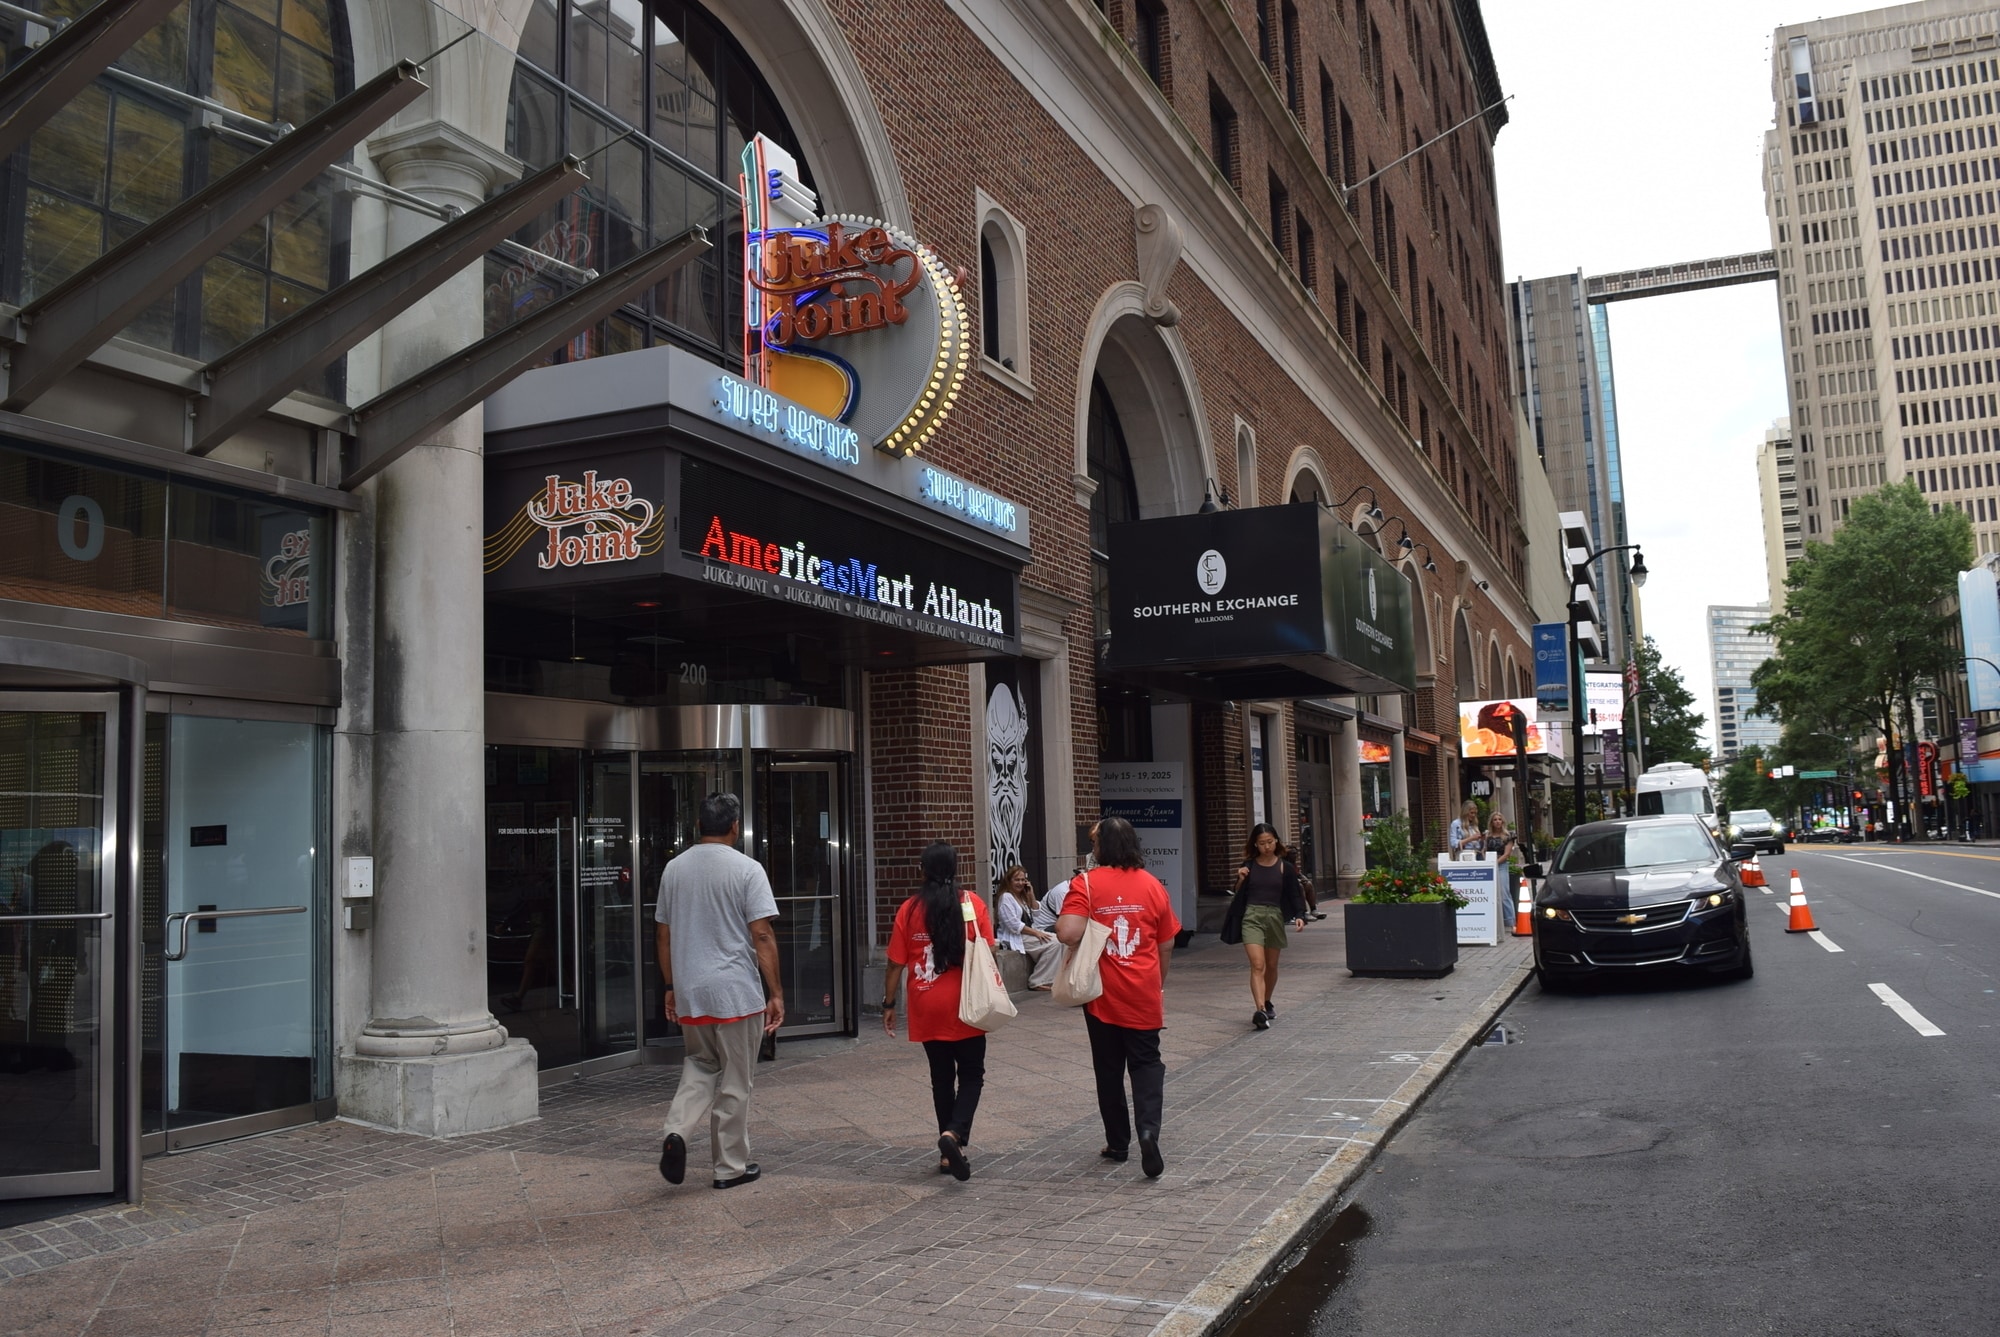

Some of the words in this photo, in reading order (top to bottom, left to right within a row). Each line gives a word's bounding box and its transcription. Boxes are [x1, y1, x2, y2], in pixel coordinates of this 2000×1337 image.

[762, 222, 893, 285] Juke
[766, 279, 909, 346] Joint
[719, 375, 779, 432] sweet
[537, 470, 632, 518] Juke
[925, 467, 965, 510] sweet
[538, 521, 641, 569] Joint
[700, 515, 915, 610] AmericasMart
[922, 581, 1004, 633] Atlanta
[703, 565, 734, 586] JUKE
[734, 573, 768, 594] JOINT
[785, 586, 812, 605] JUKE
[812, 593, 841, 612] JOINT
[855, 604, 878, 621] JUKE
[878, 610, 904, 627] JOINT
[915, 619, 936, 634] JUKE
[936, 624, 958, 640] JOINT
[967, 632, 986, 646] JUKE
[986, 636, 1005, 650] JOINT
[1133, 601, 1212, 618] SOUTHERN
[1216, 594, 1299, 612] EXCHANGE
[1194, 614, 1234, 624] BALLROOMS
[679, 662, 707, 686] 200
[1103, 771, 1119, 781] July
[1121, 771, 1131, 780] 15
[1138, 771, 1149, 780] 19,
[1151, 771, 1172, 780] 2025
[1143, 786, 1176, 794] experience
[1149, 859, 1164, 867] 7pm
[1153, 848, 1179, 856] EVENT
